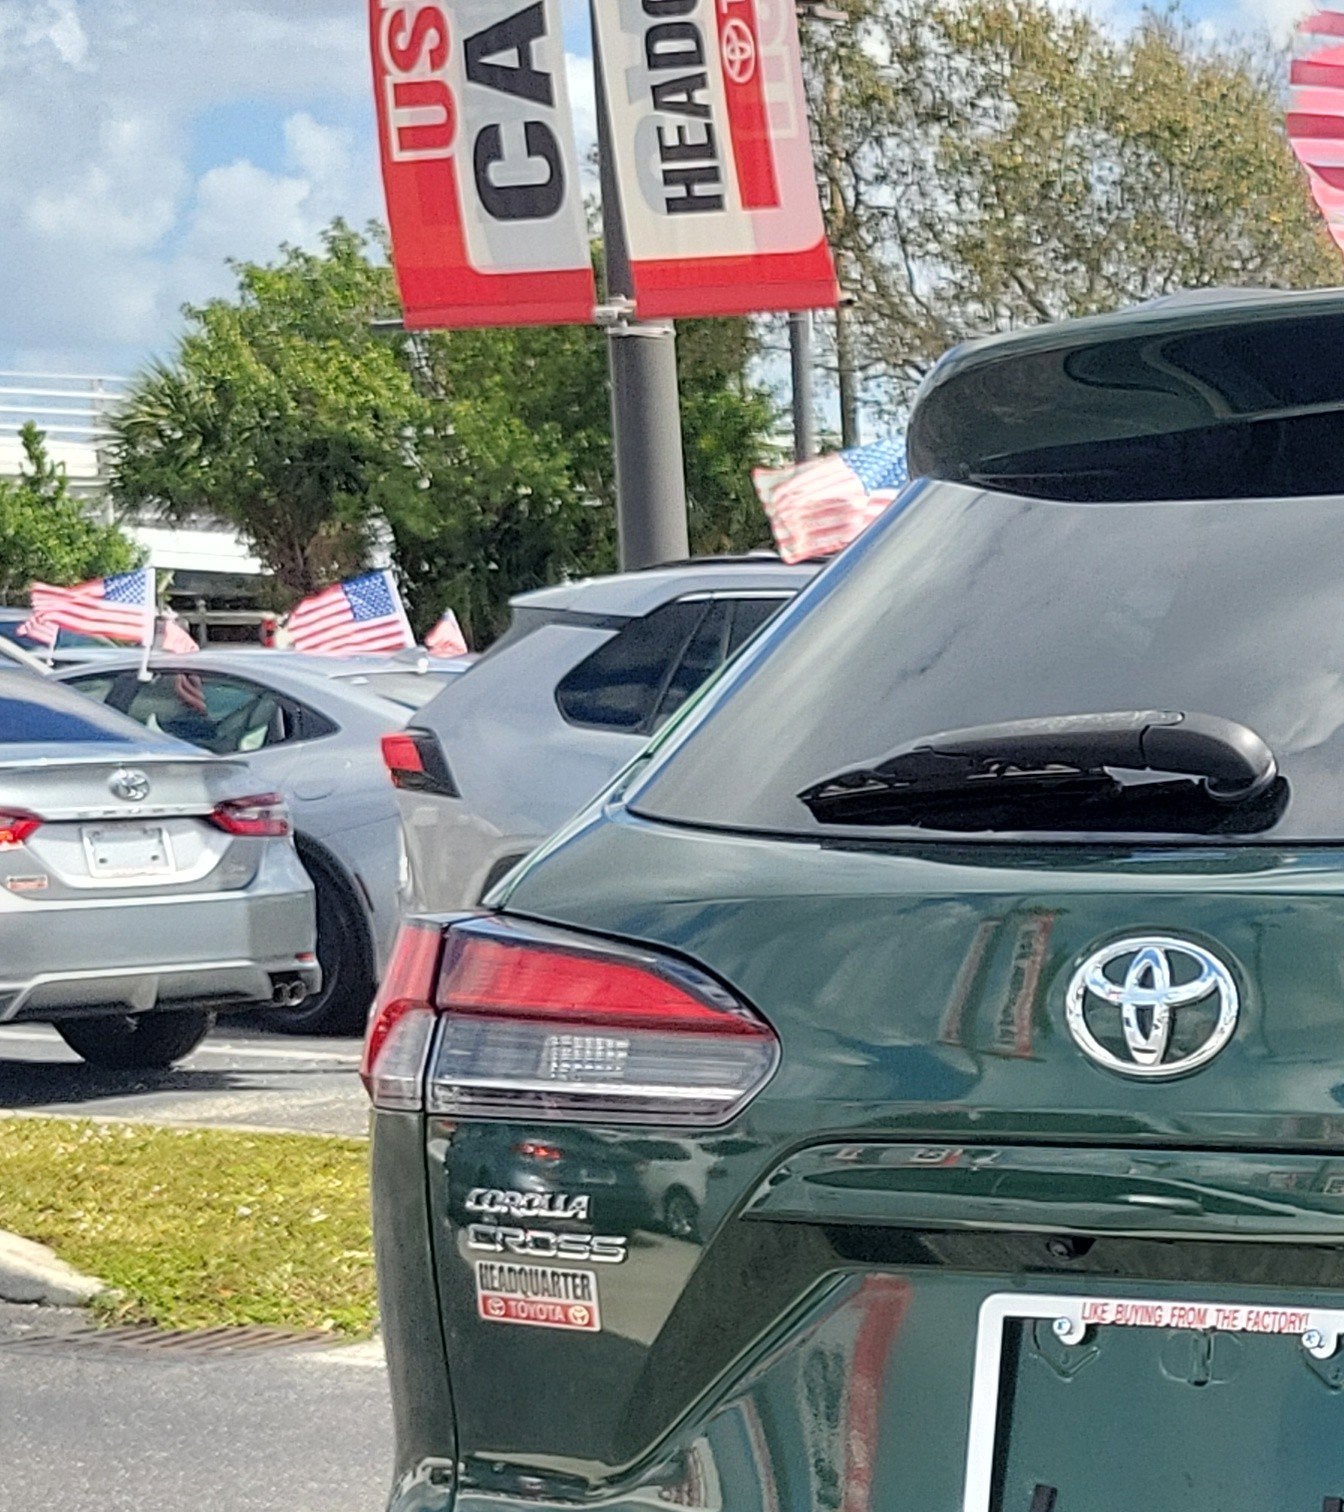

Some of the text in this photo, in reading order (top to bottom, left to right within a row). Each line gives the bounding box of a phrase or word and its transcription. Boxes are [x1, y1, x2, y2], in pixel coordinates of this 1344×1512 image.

[465, 1187, 591, 1220] COROLLA
[468, 1223, 628, 1264] CROSS
[478, 1261, 593, 1301] HEADQUARTER
[509, 1301, 566, 1322] TOYOTA
[1081, 1302, 1109, 1321] LIKE
[1114, 1303, 1163, 1324] BUYING
[1169, 1306, 1208, 1326] FROM
[1215, 1308, 1240, 1328] THE
